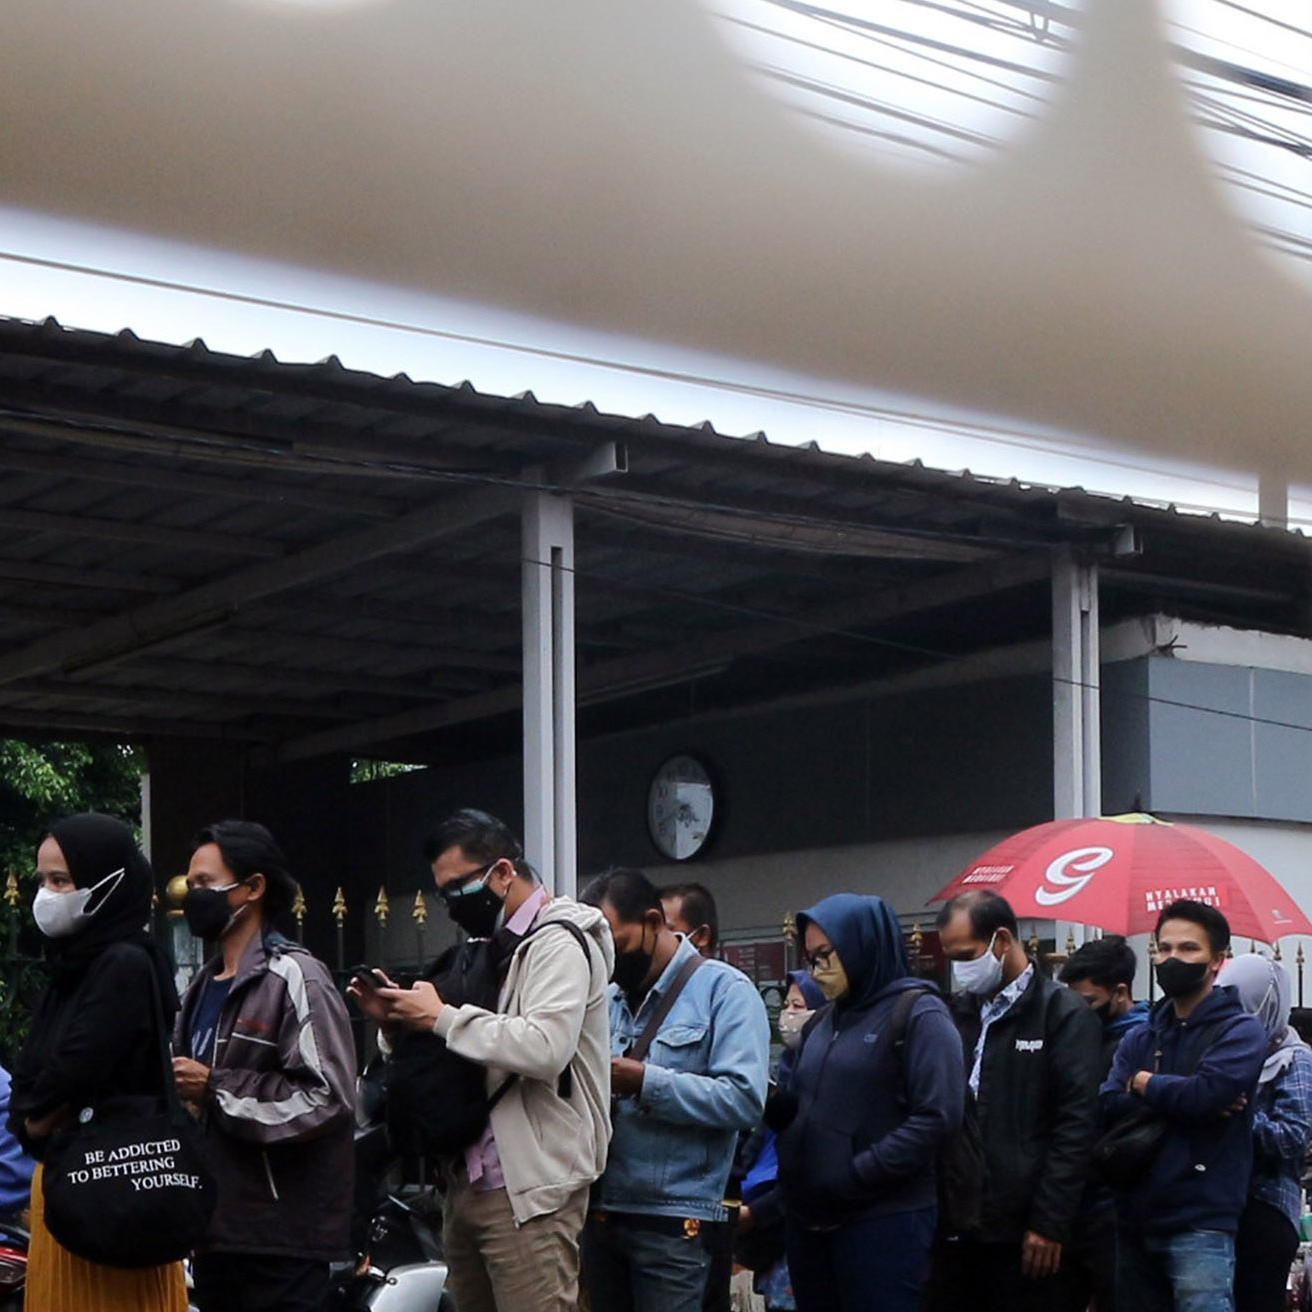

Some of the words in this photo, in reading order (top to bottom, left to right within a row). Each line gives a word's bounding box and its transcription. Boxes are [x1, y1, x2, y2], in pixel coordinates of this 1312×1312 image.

[1145, 886, 1217, 902] NYALAKAN
[85, 1150, 105, 1165] BE
[108, 1139, 181, 1162] ADDICTED
[67, 1170, 89, 1184] TO
[92, 1156, 175, 1180] BETTERING
[131, 1172, 203, 1191] YOURSELF.
